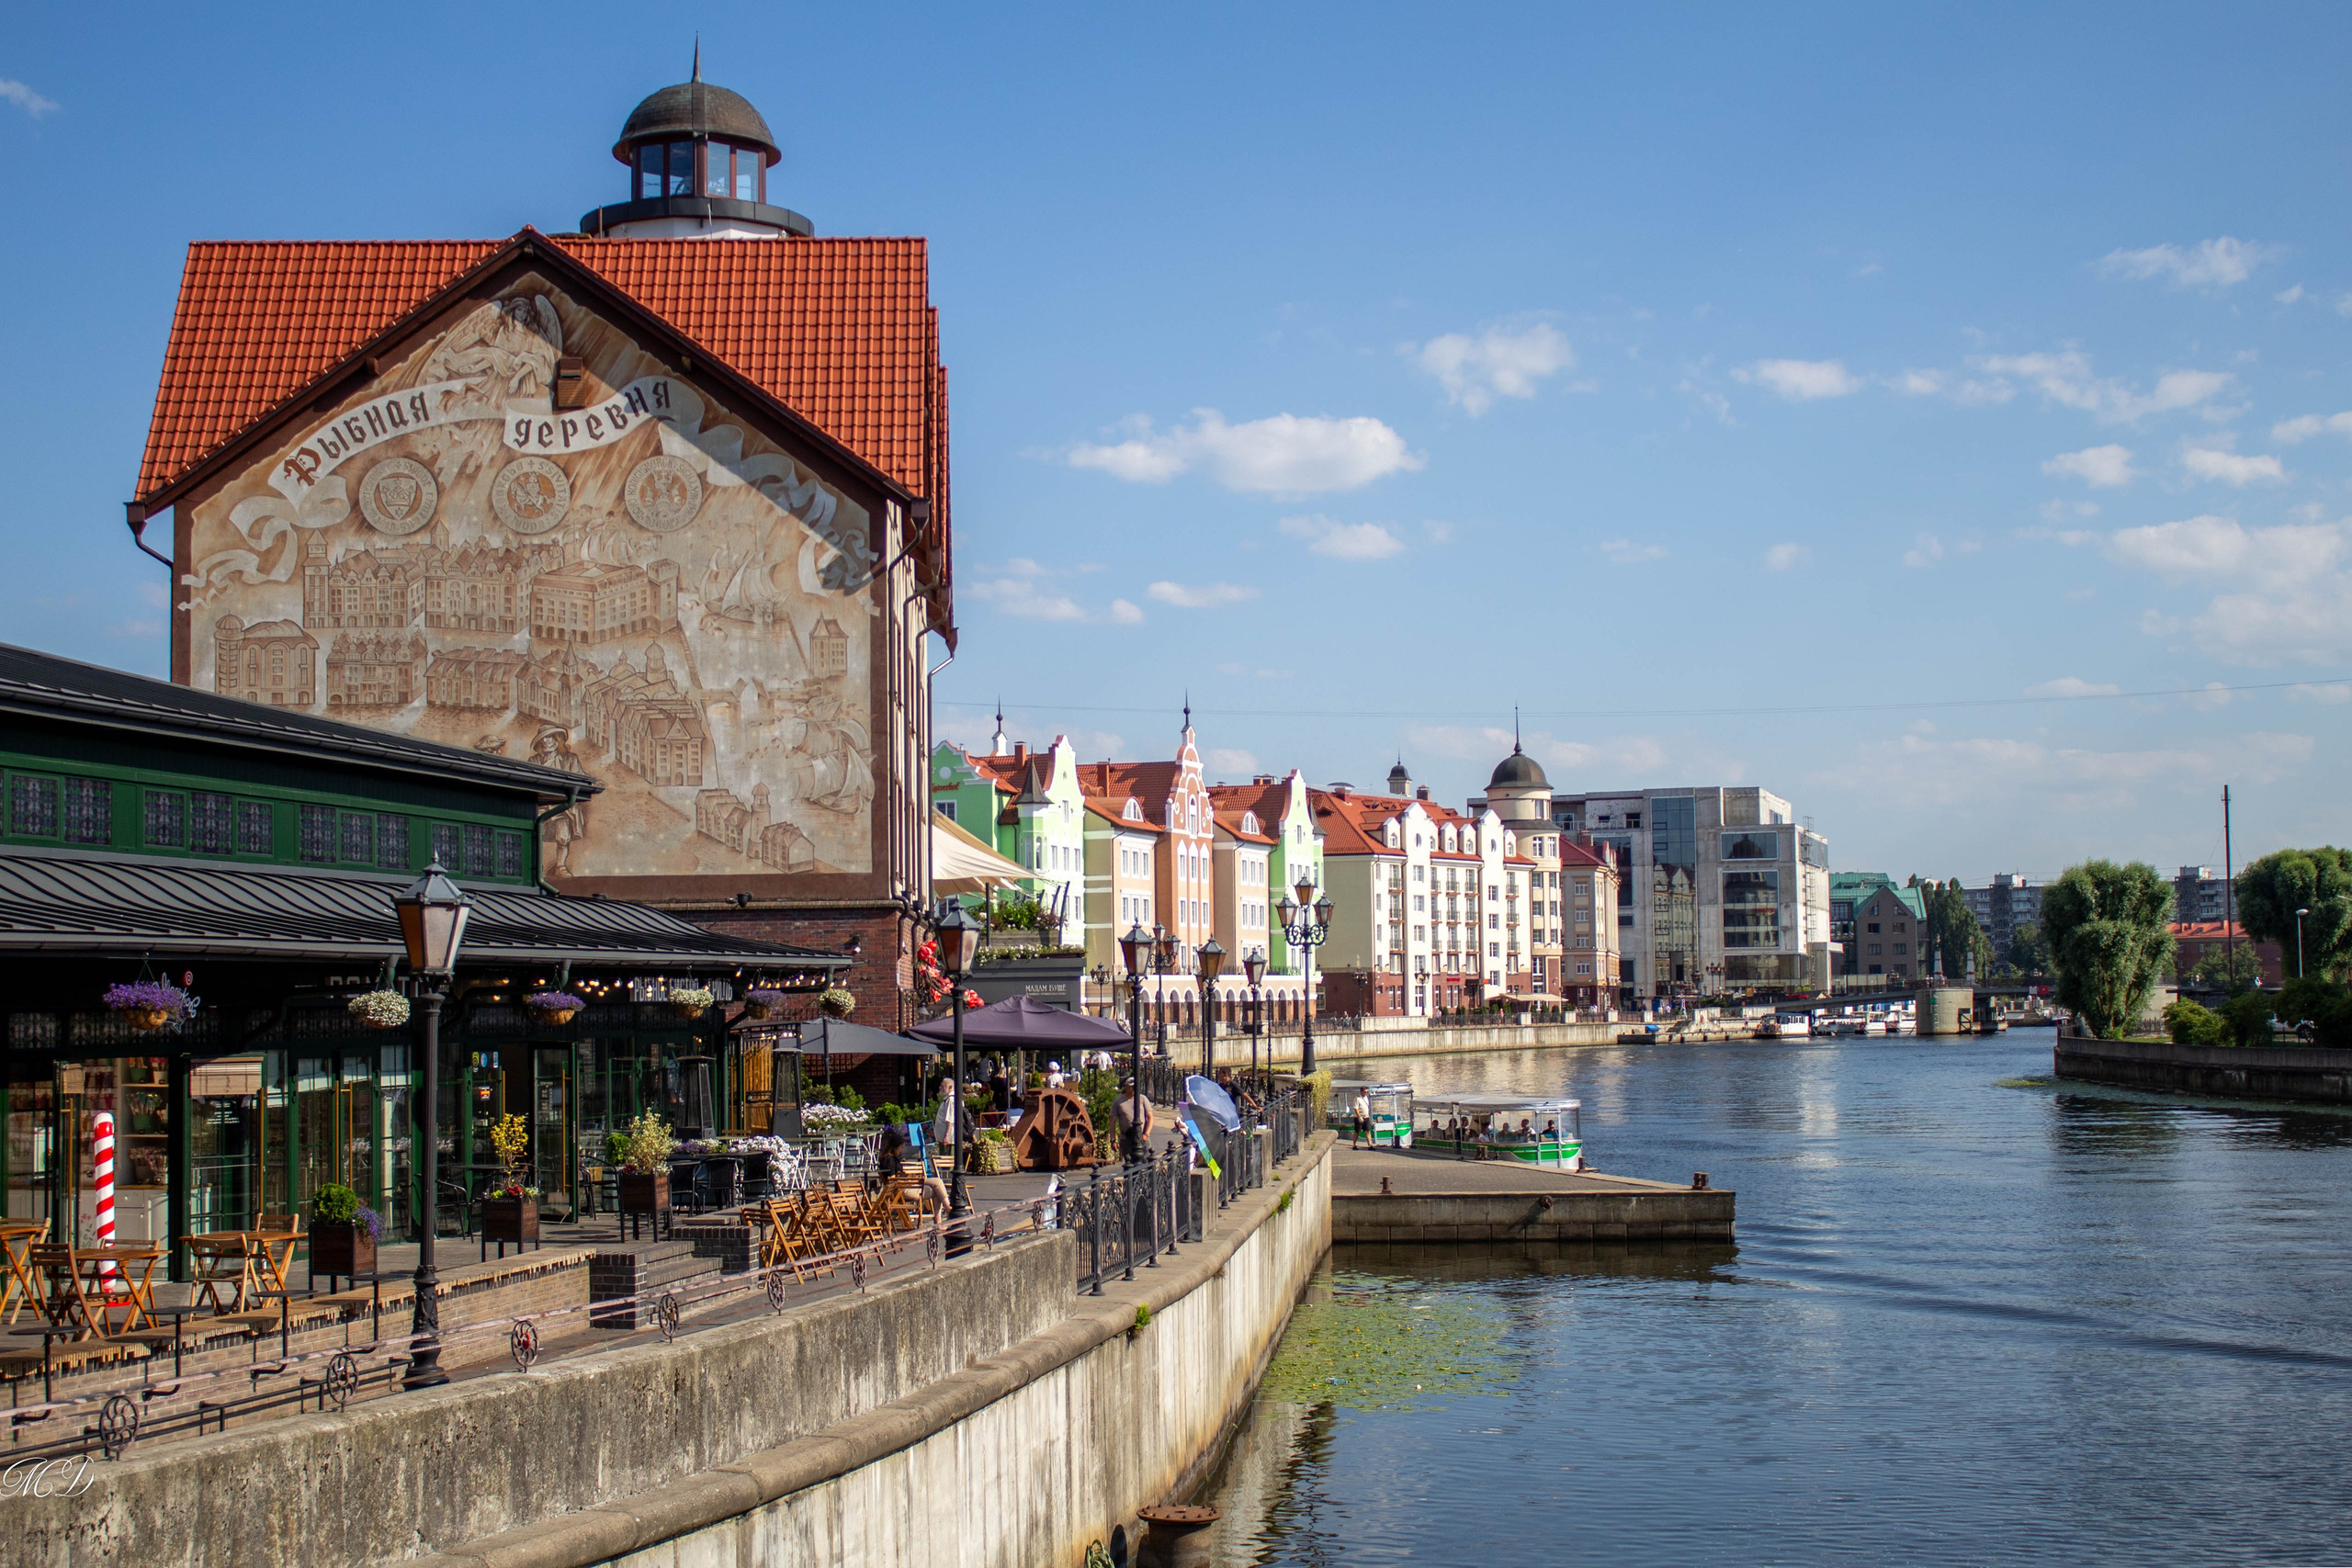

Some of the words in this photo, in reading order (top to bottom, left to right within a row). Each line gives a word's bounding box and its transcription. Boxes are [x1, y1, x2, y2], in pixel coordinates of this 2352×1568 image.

[283, 390, 431, 488] Рыбная
[514, 379, 672, 449] деревня
[1025, 984, 1047, 992] МАДАМ
